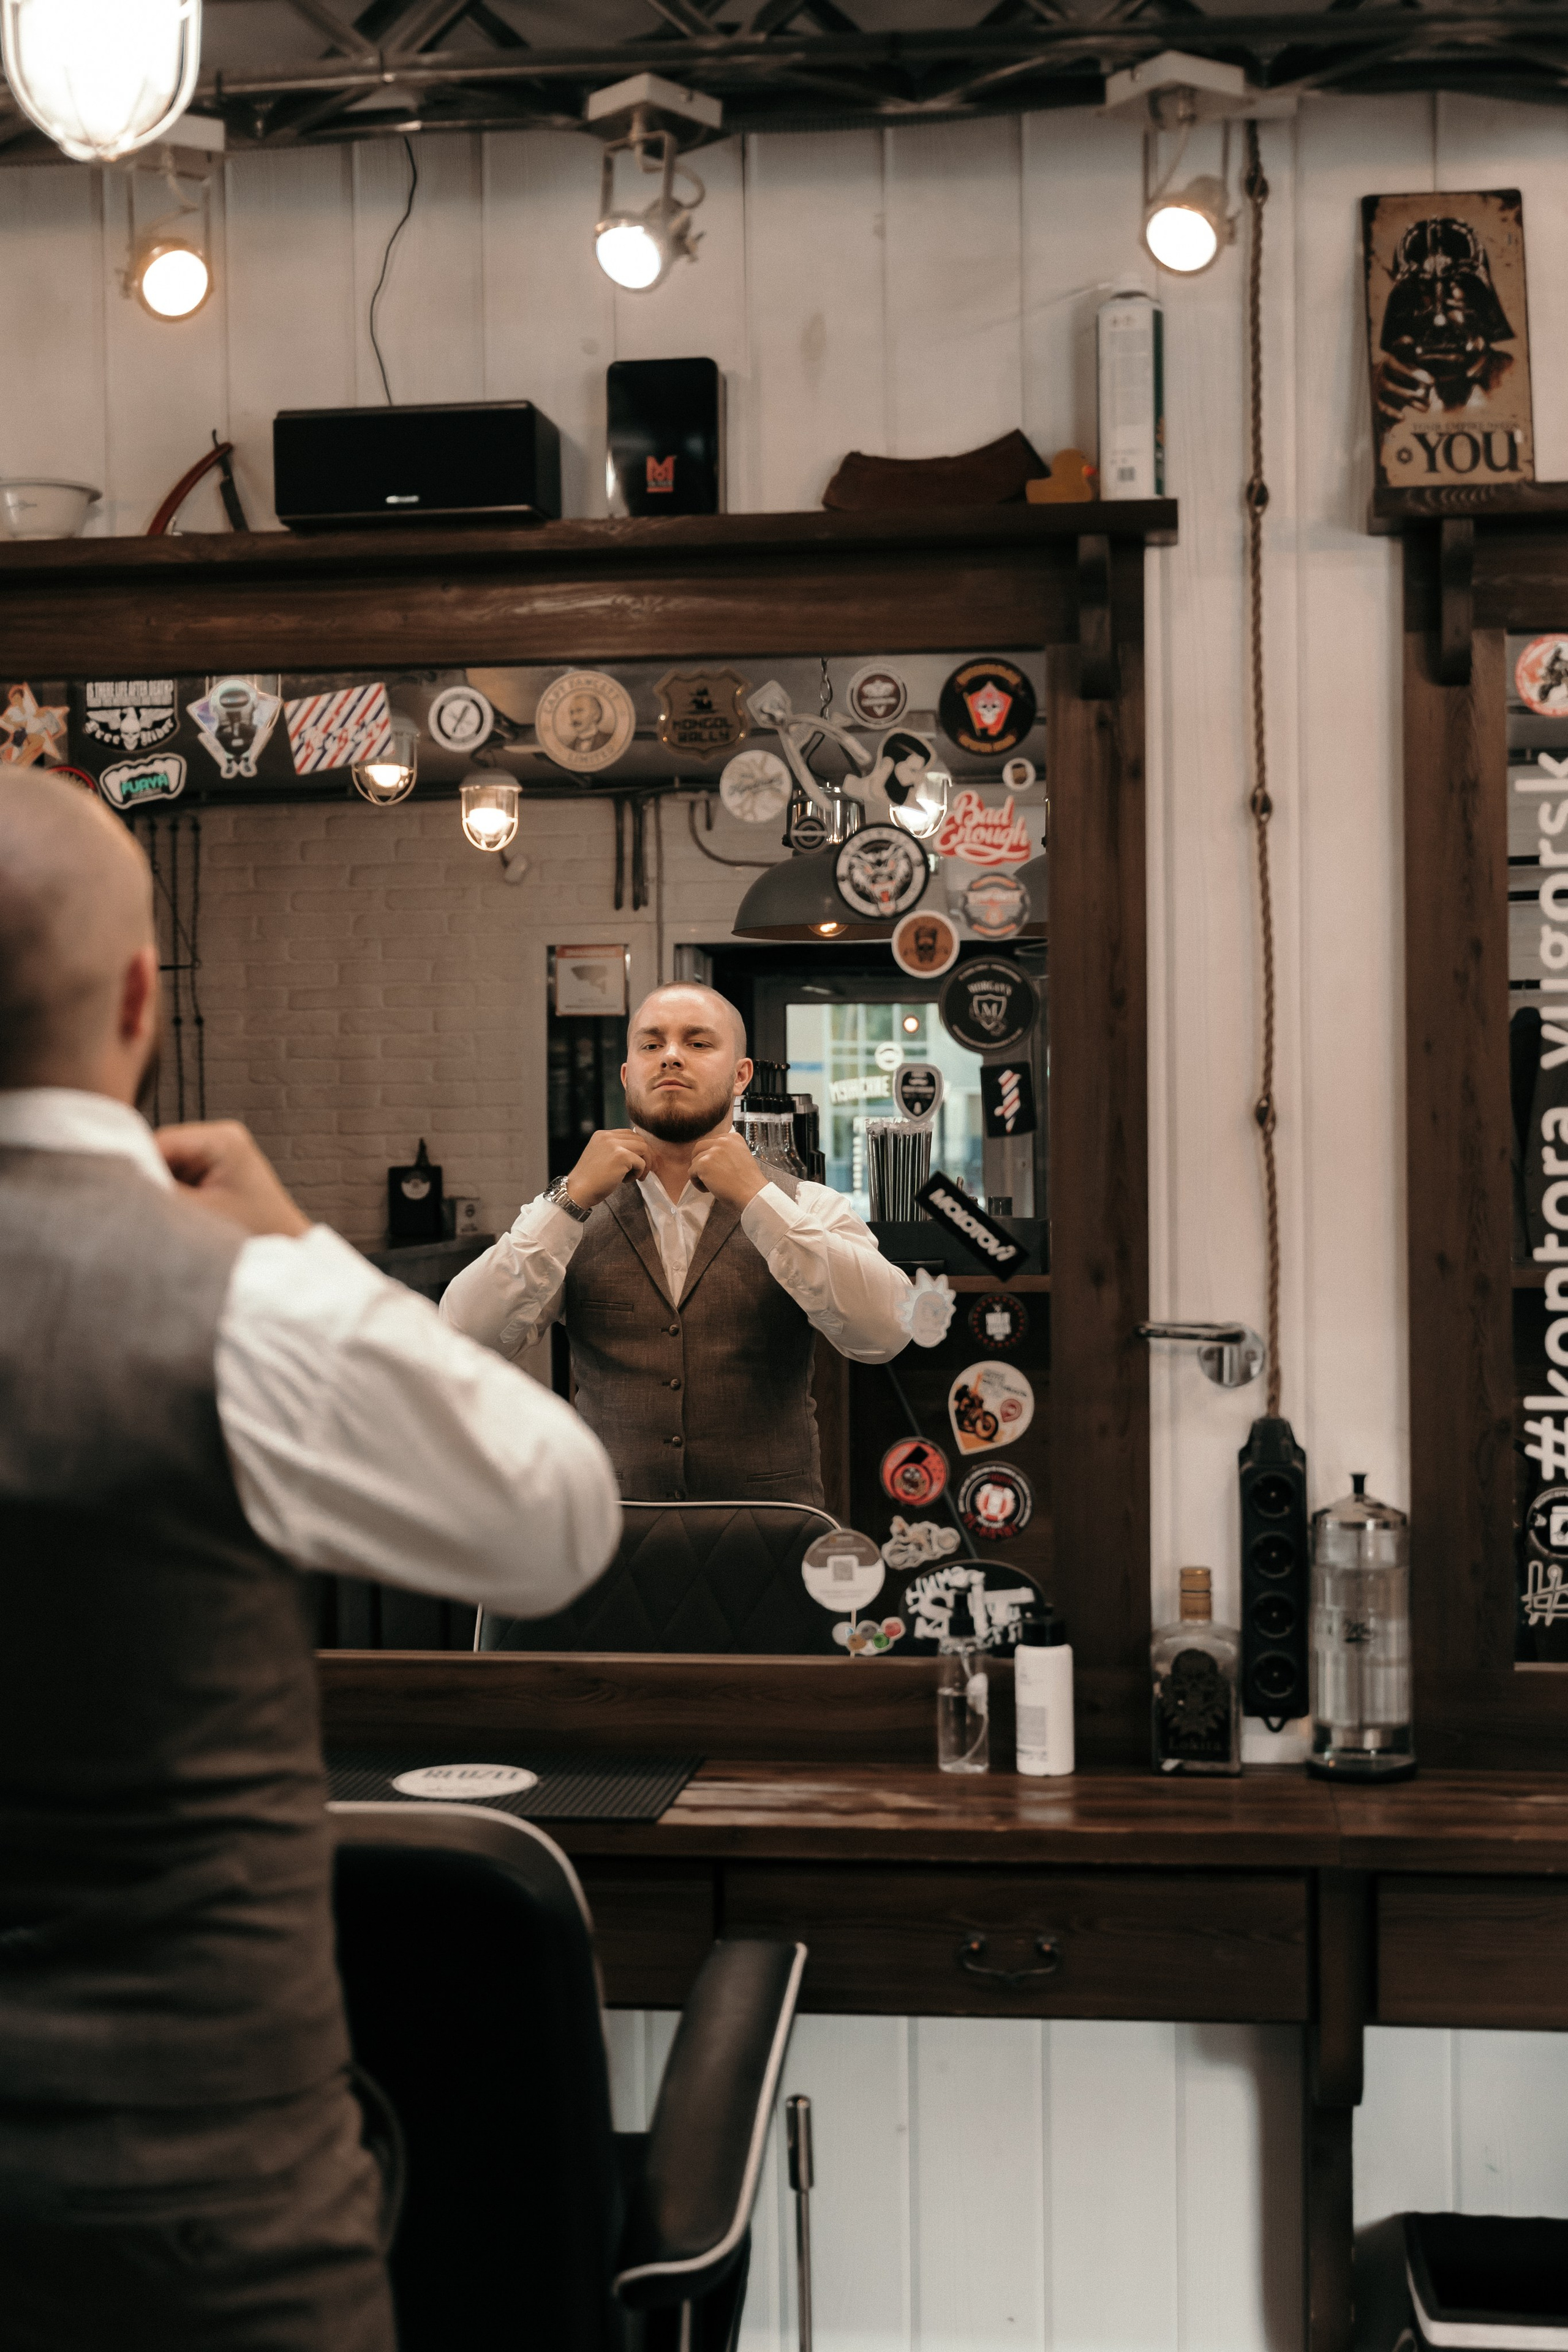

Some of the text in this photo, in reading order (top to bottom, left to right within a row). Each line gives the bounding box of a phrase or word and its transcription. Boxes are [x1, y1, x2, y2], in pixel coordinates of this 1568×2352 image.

[1410, 431, 1523, 474] YOU
[952, 790, 1014, 827] Bad
[933, 811, 1031, 865] Enough
